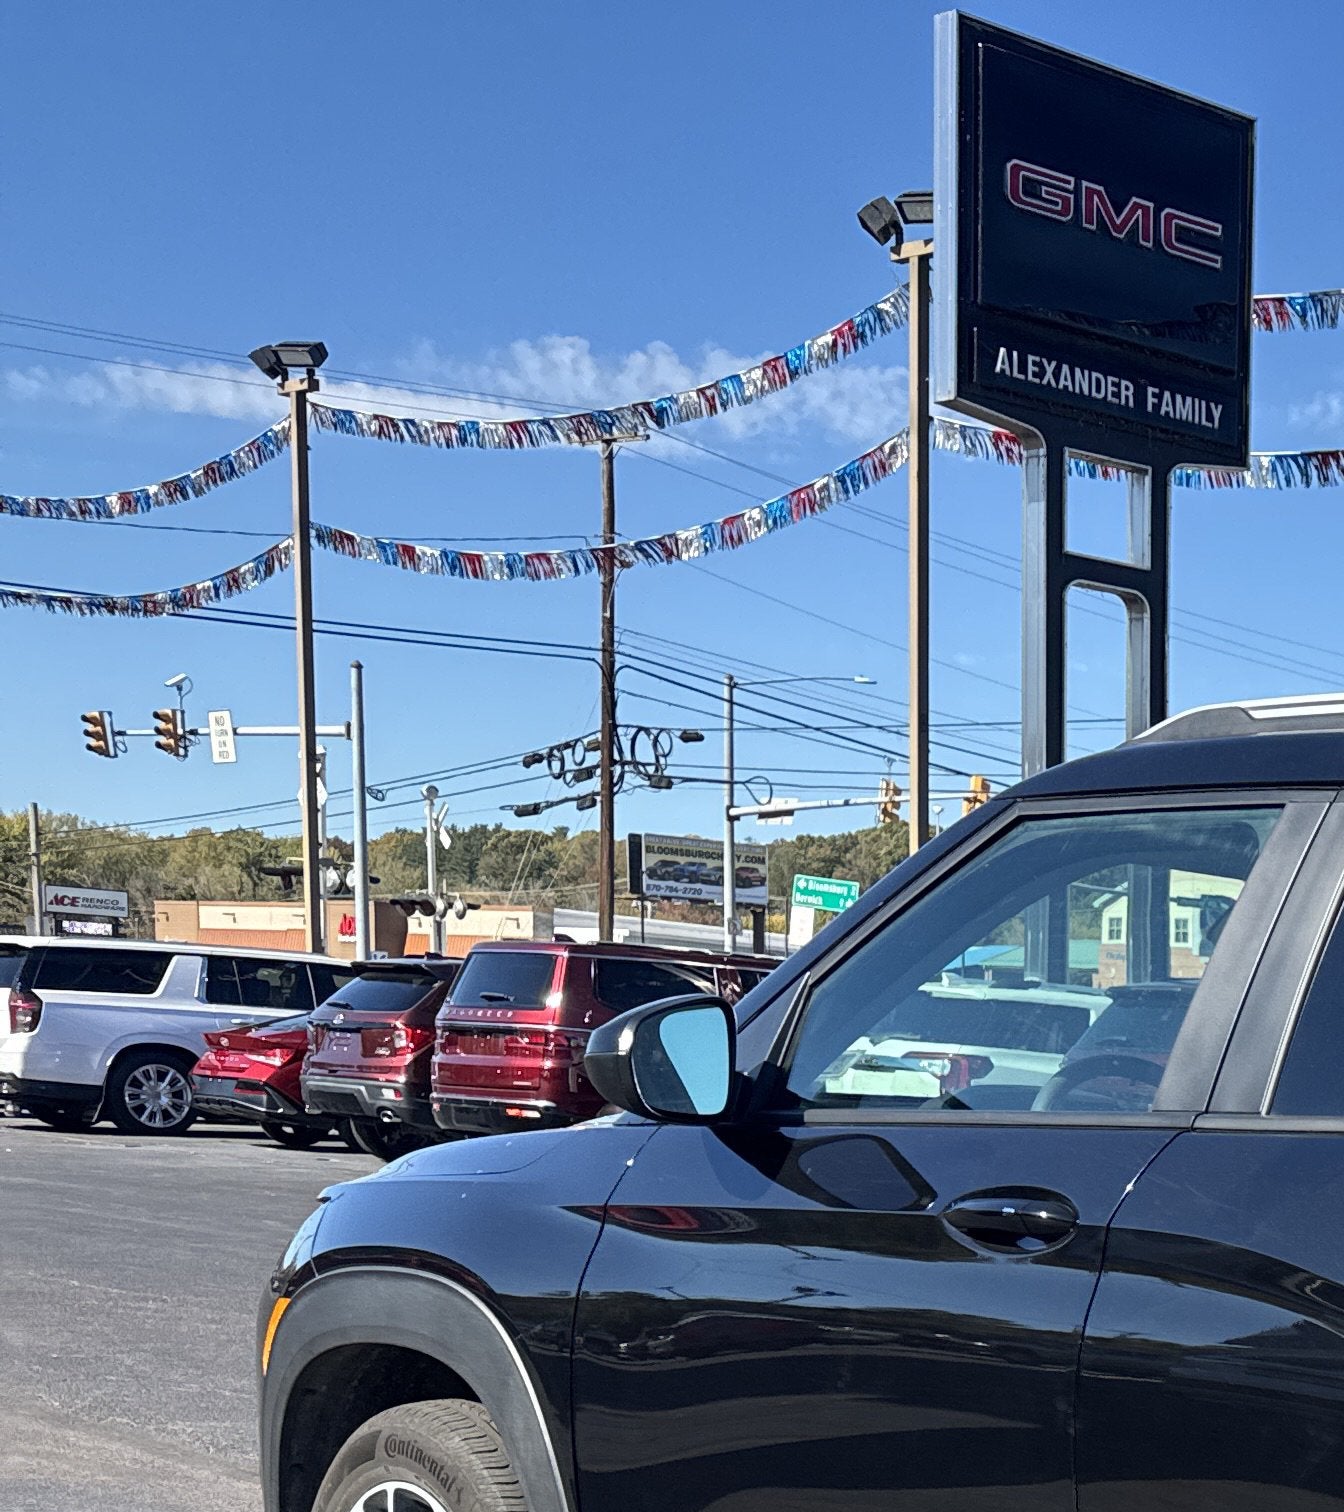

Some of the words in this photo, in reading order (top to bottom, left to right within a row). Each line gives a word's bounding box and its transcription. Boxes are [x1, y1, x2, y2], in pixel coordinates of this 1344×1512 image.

[1005, 158, 1223, 270] GMC
[995, 345, 1135, 409] ALEXANDER
[1146, 385, 1224, 431] FAMILY
[214, 715, 225, 726] NO
[48, 892, 80, 908] ACE
[81, 896, 120, 906] RENCO
[384, 1432, 457, 1493] Continental
